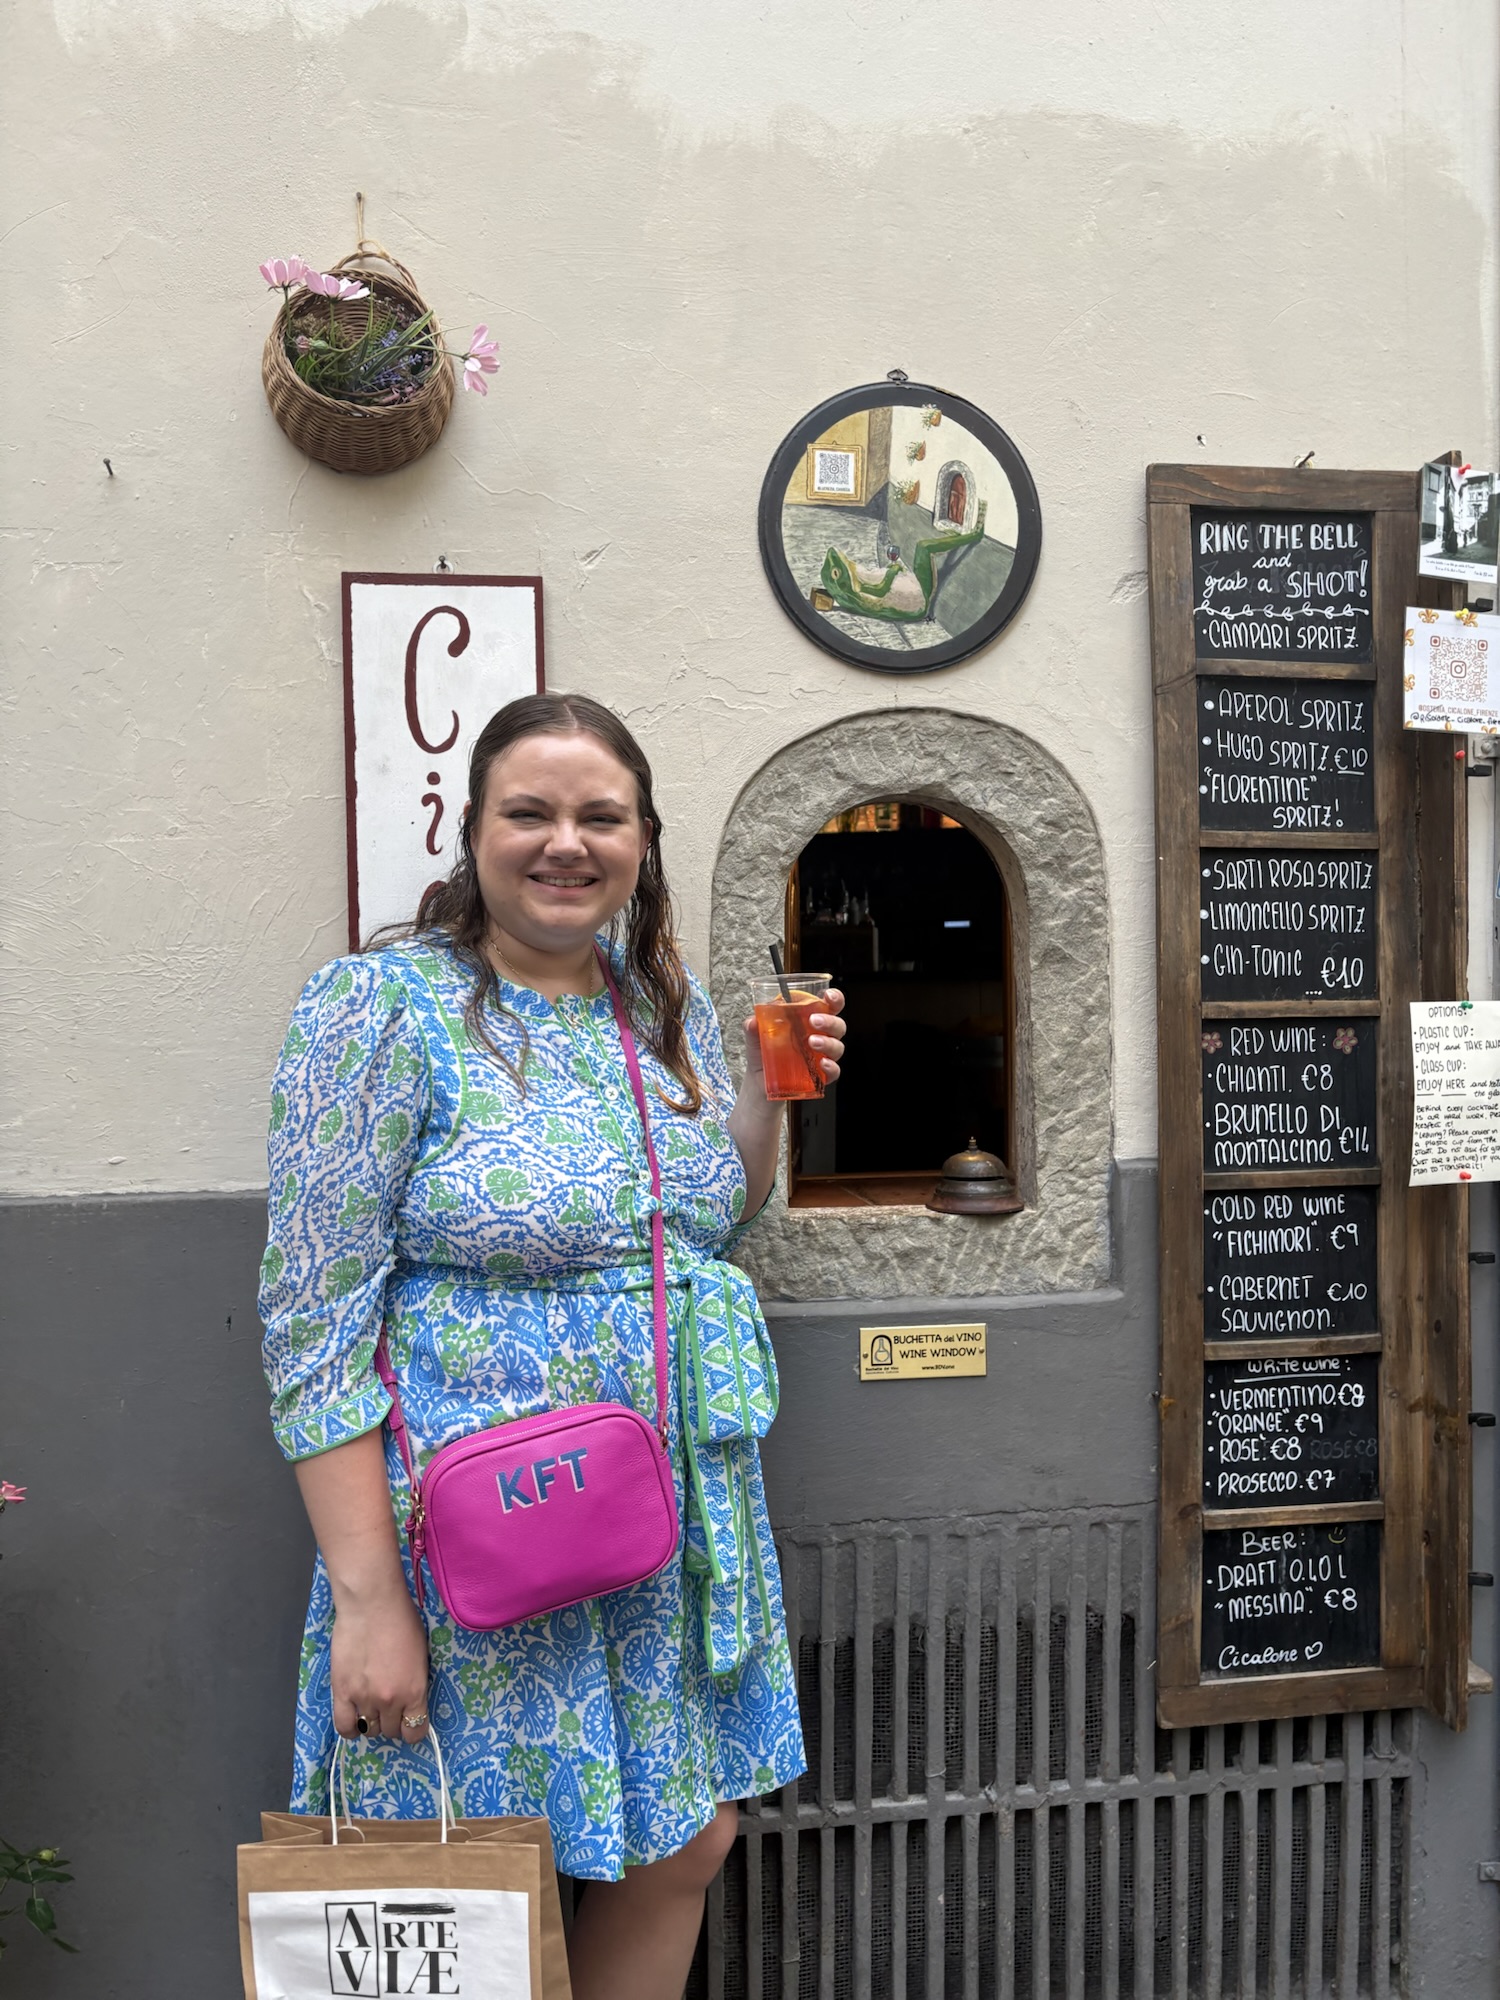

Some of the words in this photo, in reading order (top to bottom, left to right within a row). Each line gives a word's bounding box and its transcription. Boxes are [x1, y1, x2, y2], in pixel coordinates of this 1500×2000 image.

[1200, 522, 1249, 554] RING
[1259, 524, 1303, 549] THE
[1310, 523, 1358, 550] BELL
[1253, 553, 1292, 568] and
[1203, 571, 1248, 598] grab
[1257, 578, 1272, 592] a
[1286, 560, 1368, 598] SHOT!
[1209, 620, 1290, 649] CAMPARI
[1297, 626, 1358, 649] SPRITZ.
[1219, 688, 1293, 726] APEROL
[1217, 729, 1263, 762] HUGO
[1334, 747, 1368, 770] €10
[1273, 799, 1344, 829] SPRITZ!
[1213, 859, 1262, 890] SARTI
[1268, 858, 1314, 888] ROSA
[1210, 901, 1303, 931] LIMONCELLO
[1321, 957, 1363, 989] €10
[1231, 1027, 1264, 1056] RED
[1419, 1026, 1449, 1040] PLASTIC
[1415, 1041, 1440, 1054] ENJOY
[1464, 1040, 1482, 1051] TAKE
[1301, 1064, 1333, 1091] €8
[1421, 1059, 1444, 1075] GLASS
[1416, 1078, 1442, 1092] ENJOY
[1446, 1078, 1465, 1089] HERE
[1470, 1080, 1487, 1088] and
[1474, 1090, 1485, 1098] the
[1215, 1103, 1307, 1136] BRUNELLO
[1320, 1105, 1340, 1132] DI
[1338, 1126, 1369, 1154] €14
[1212, 1195, 1255, 1224] COLD
[1264, 1195, 1293, 1219] RED
[1330, 1223, 1359, 1250] €9
[1220, 1275, 1314, 1301] CABERNET
[1327, 1283, 1368, 1301] €10
[893, 1334, 942, 1345] BUCHETTA
[956, 1332, 982, 1342] VINO
[899, 1349, 927, 1359] WINE
[930, 1347, 977, 1358] WINDOW
[1338, 1383, 1366, 1407] €8
[1294, 1413, 1323, 1433] €9
[1270, 1436, 1302, 1461] €8
[496, 1447, 588, 1514] KFT
[1306, 1470, 1335, 1490] €7
[1218, 1560, 1276, 1591] DRAFT
[1324, 1588, 1358, 1611] €8
[1218, 1645, 1298, 1670] Cicalone
[336, 1908, 459, 1948] ARTE
